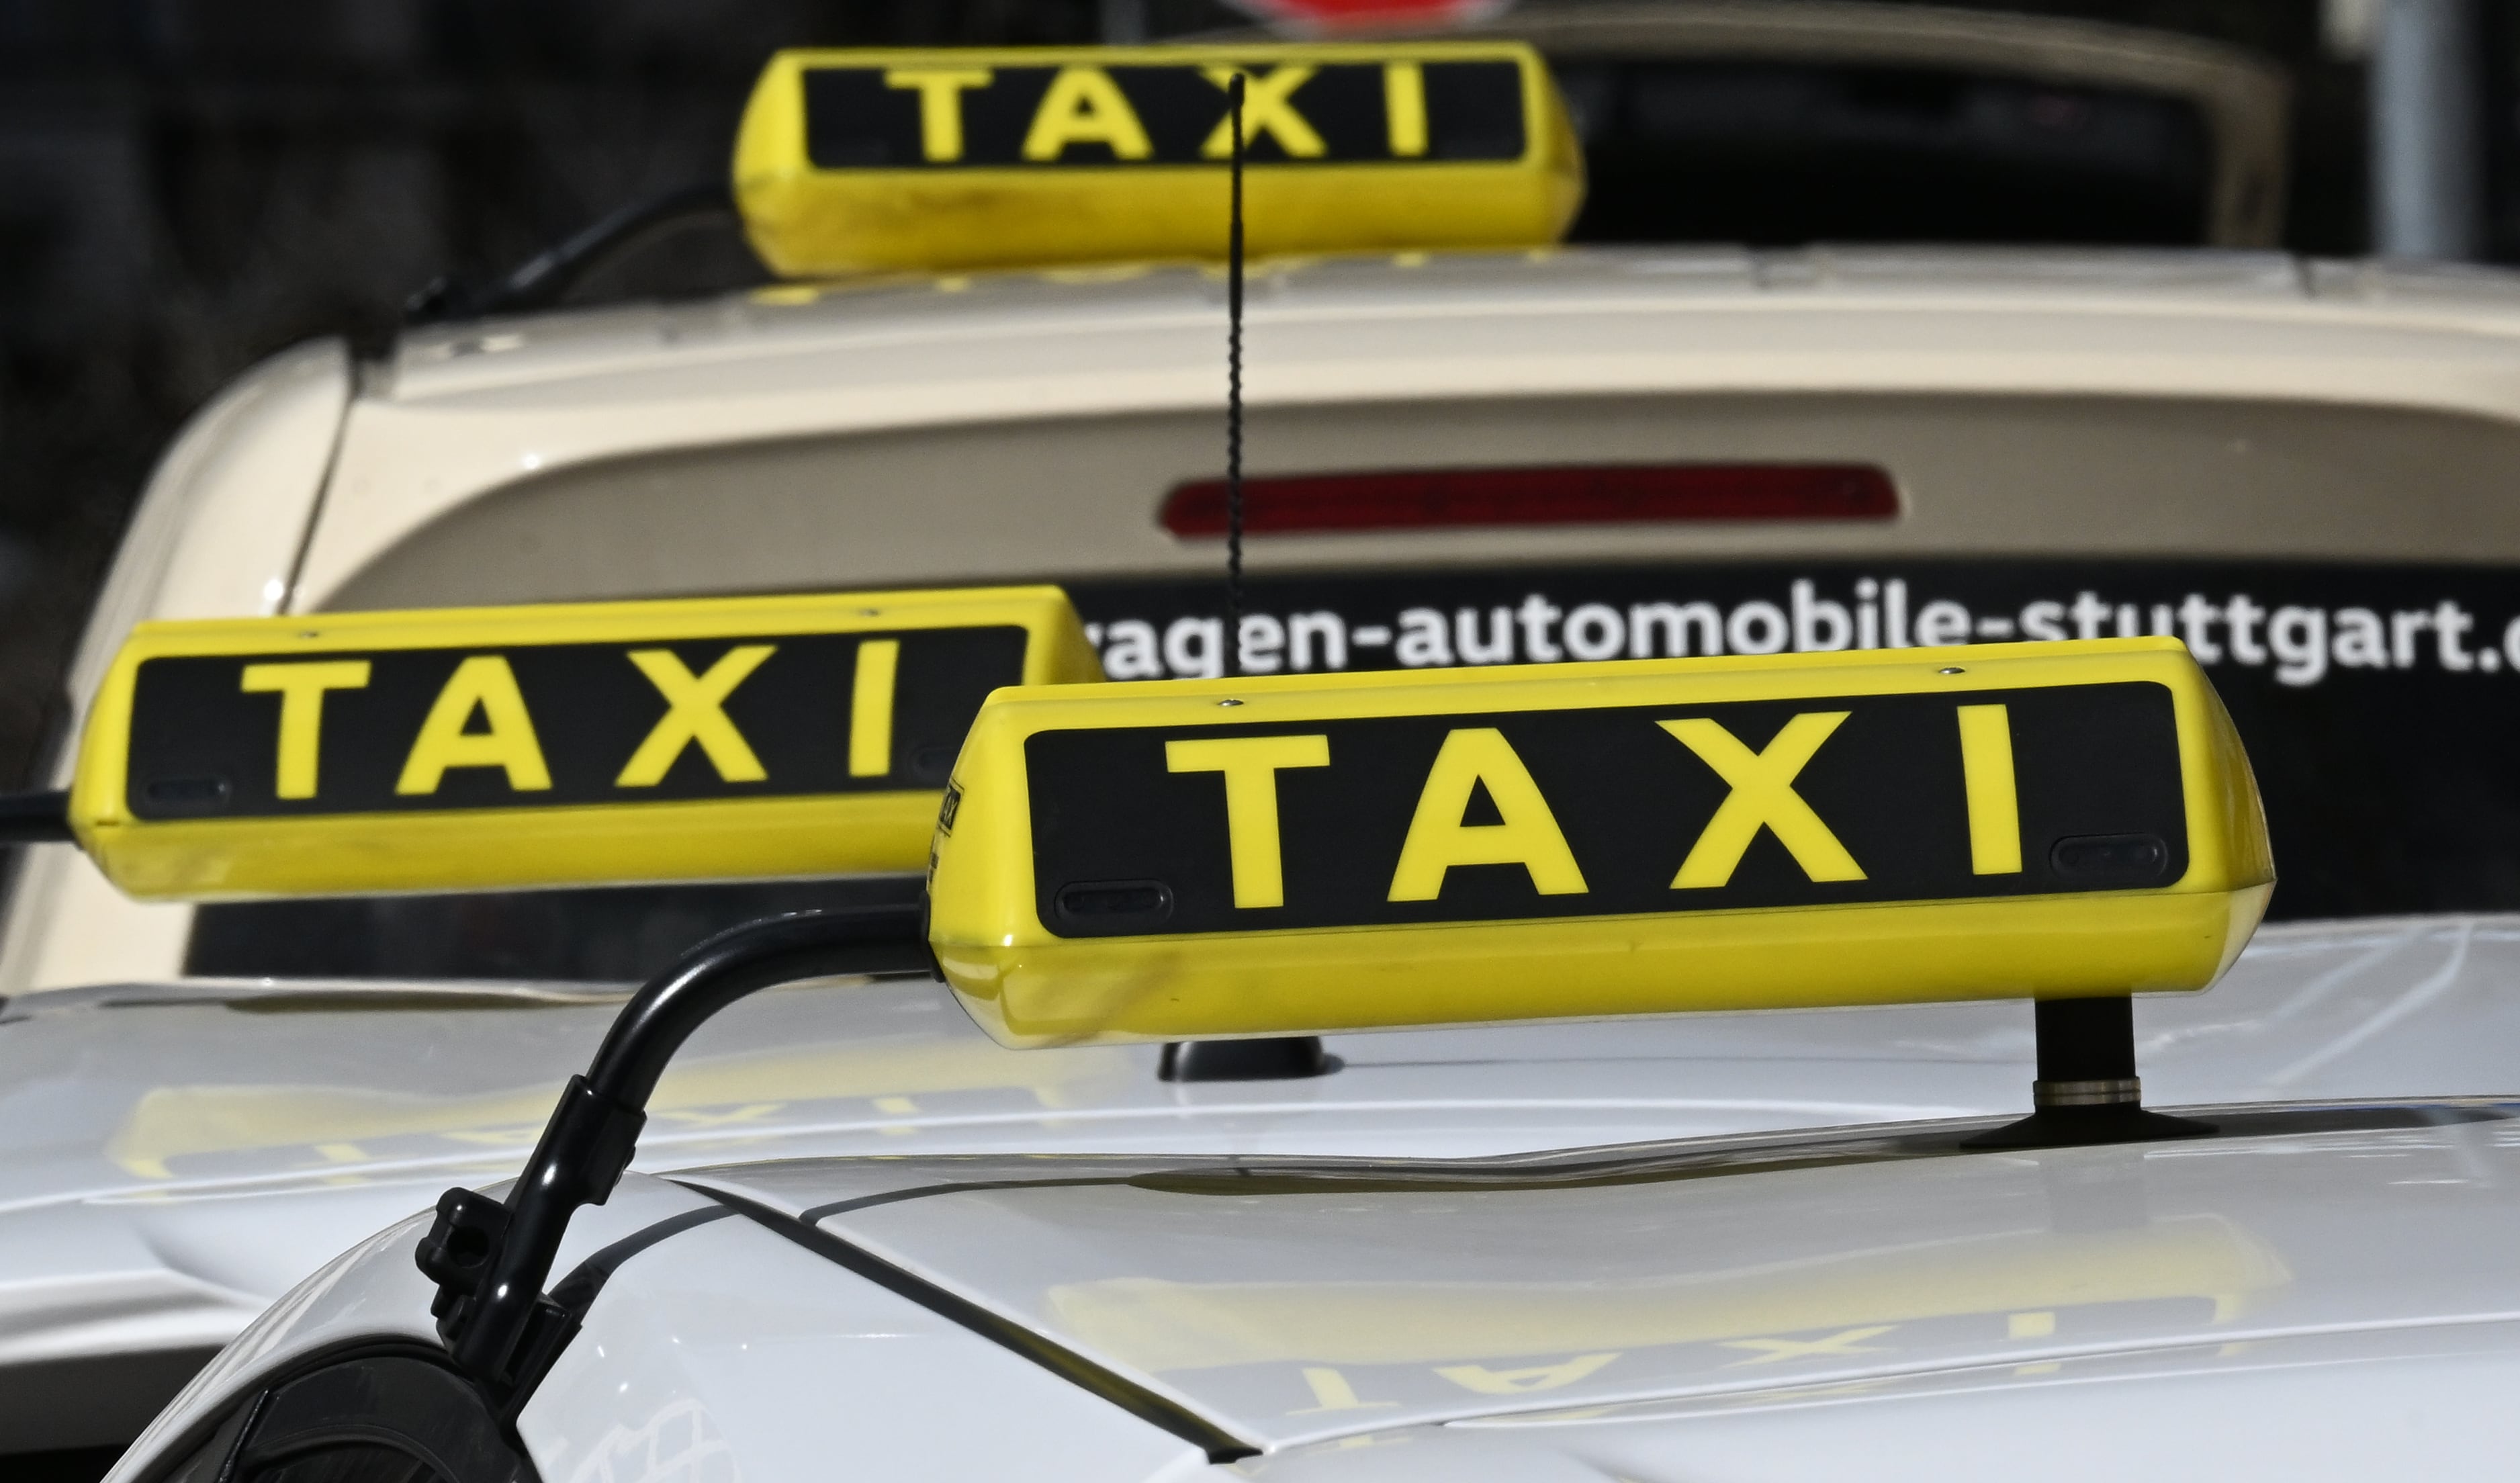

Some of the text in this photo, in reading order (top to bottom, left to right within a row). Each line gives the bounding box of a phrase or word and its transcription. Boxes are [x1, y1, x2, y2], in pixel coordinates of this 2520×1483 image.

[883, 66, 1429, 161] TAXI
[1083, 577, 2520, 686] agen-automobile-stuttgart.
[240, 639, 899, 800] TAXI
[1164, 703, 2023, 909] TAXI
